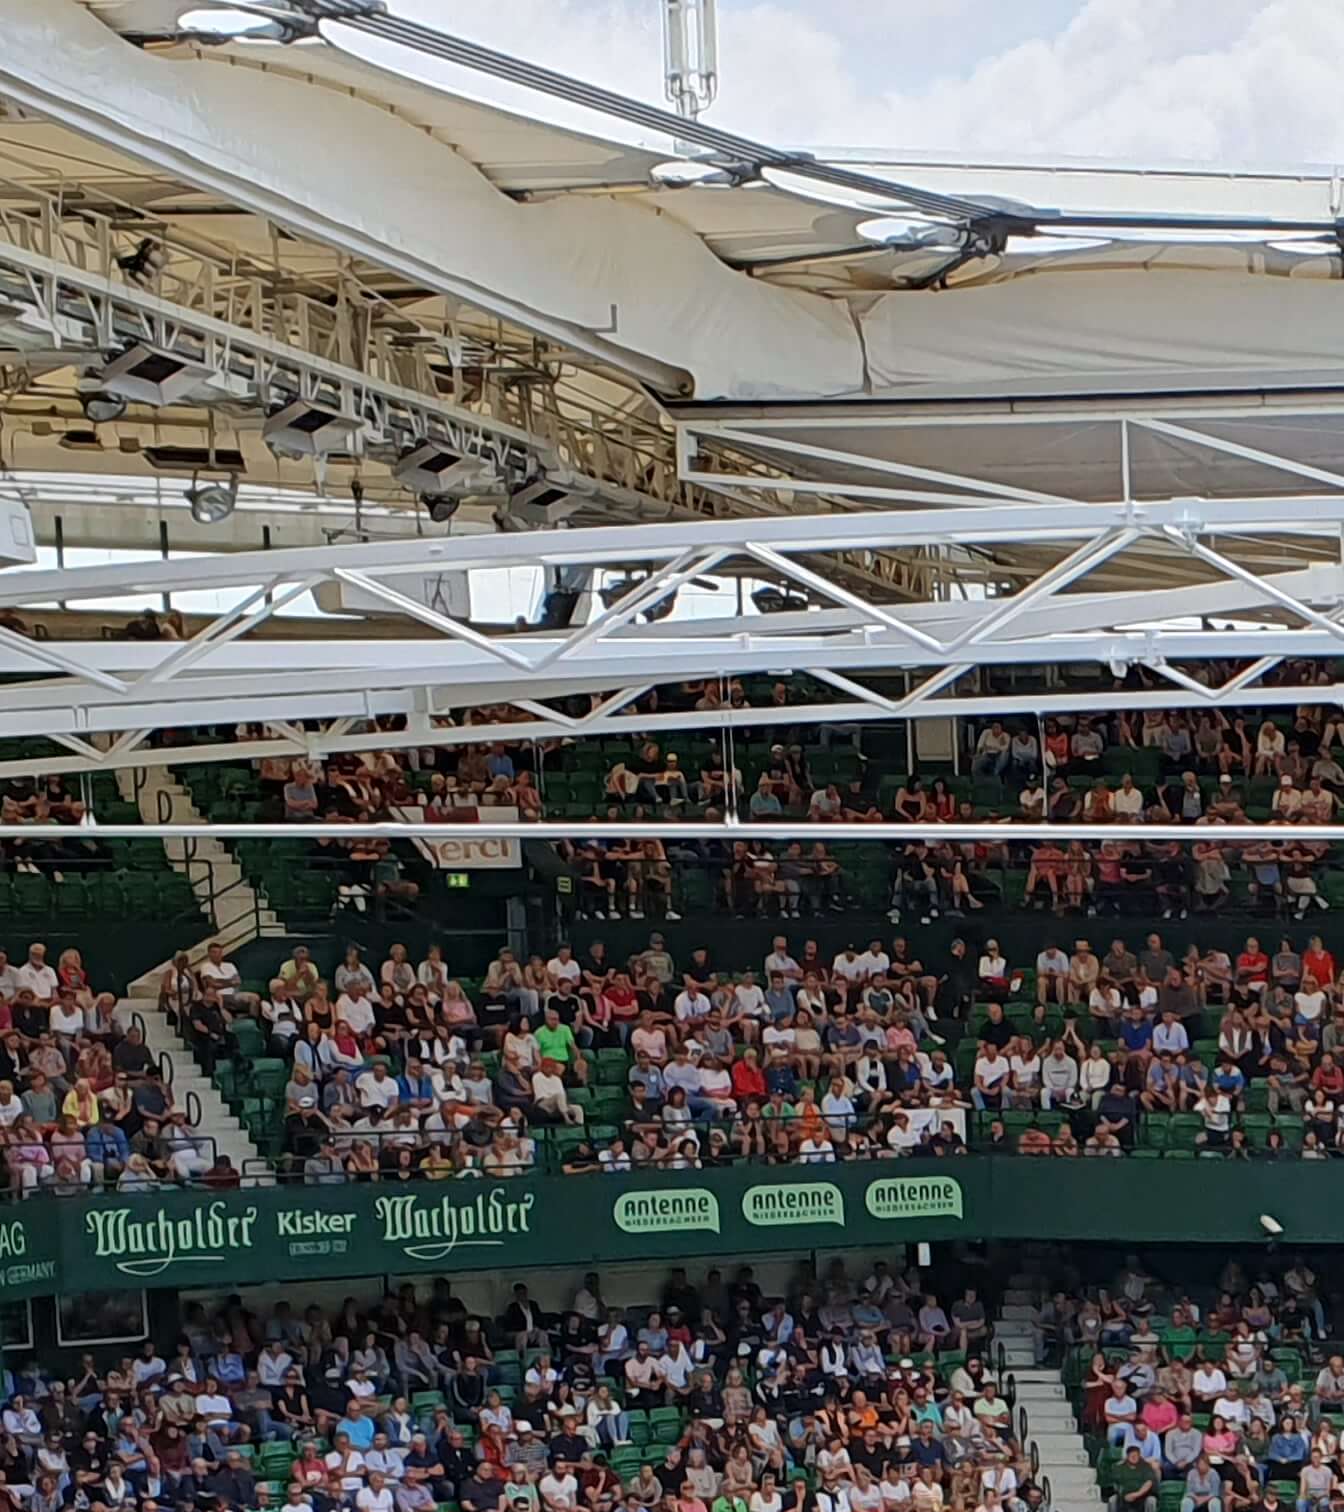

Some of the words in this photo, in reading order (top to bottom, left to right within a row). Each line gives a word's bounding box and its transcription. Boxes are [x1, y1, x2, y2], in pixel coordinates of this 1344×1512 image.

[86, 1201, 257, 1276] Wacholder
[277, 1210, 356, 1235] Kisker
[375, 1189, 534, 1260] Wacholder
